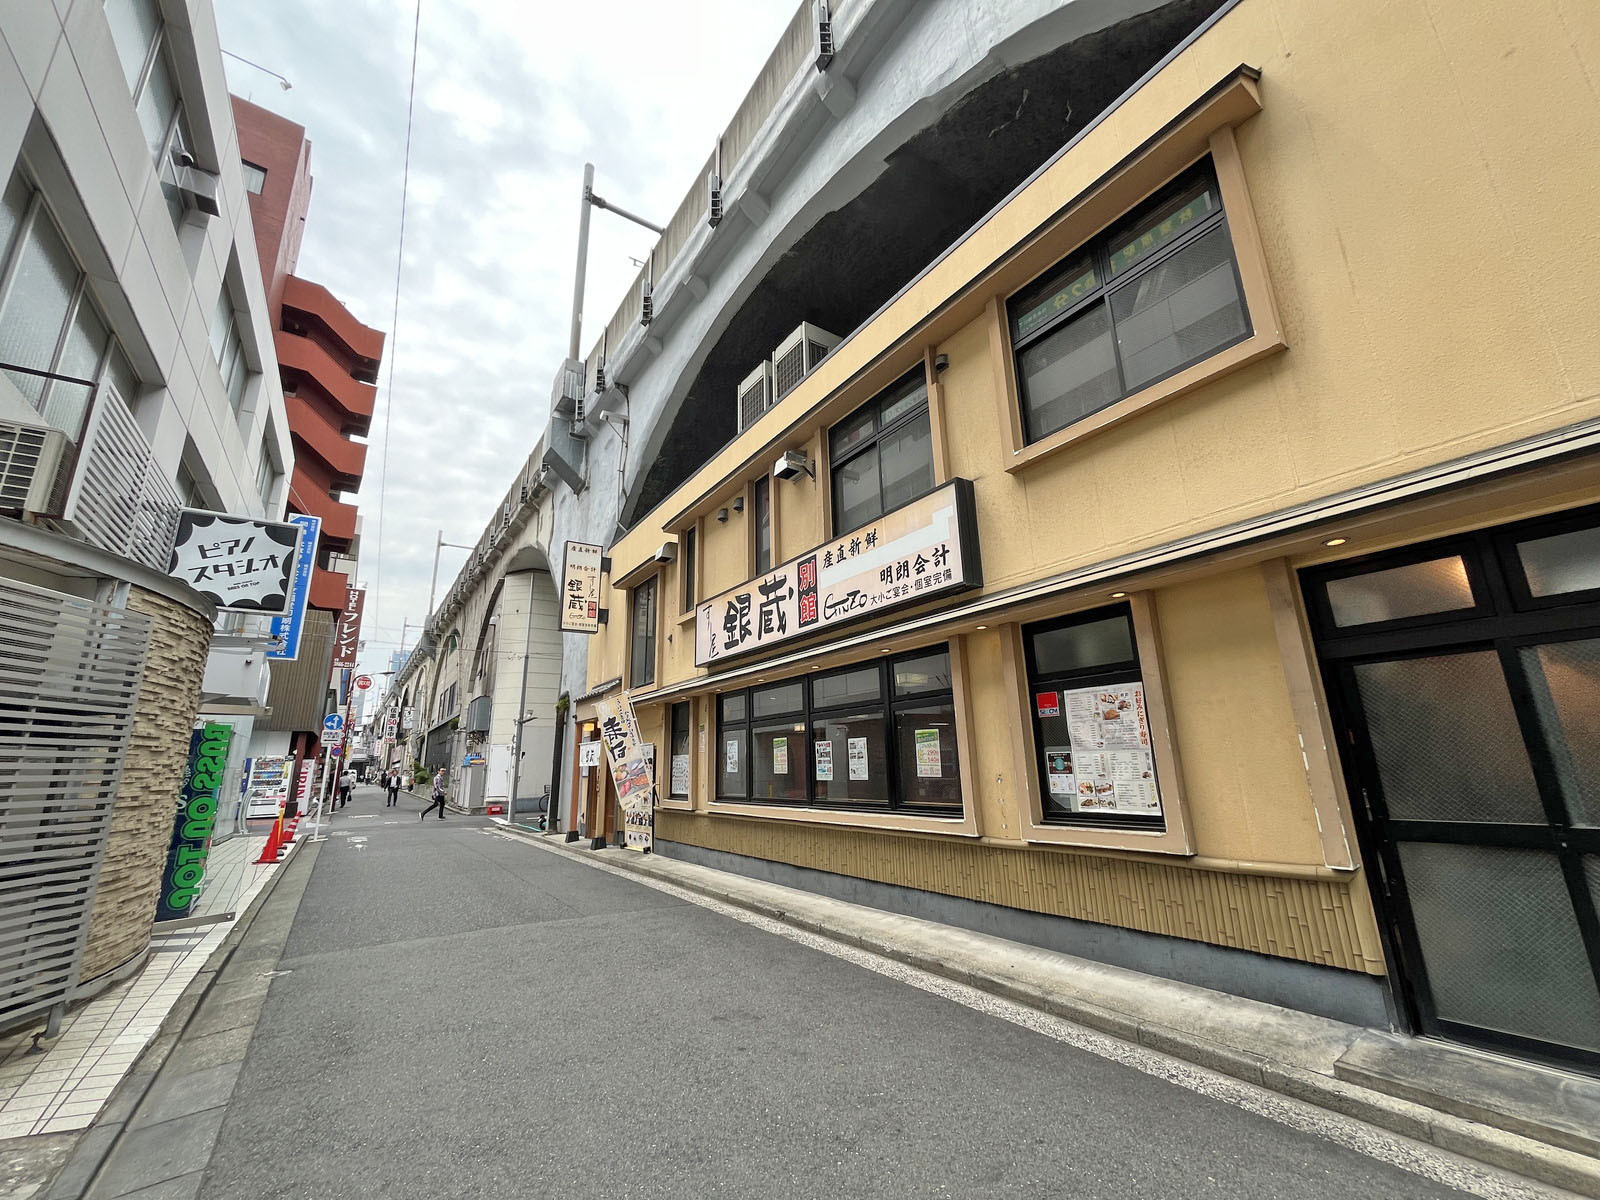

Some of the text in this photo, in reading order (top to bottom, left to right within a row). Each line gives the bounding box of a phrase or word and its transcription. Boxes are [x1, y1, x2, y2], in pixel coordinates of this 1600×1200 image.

[198, 536, 256, 560] ピアノ
[822, 527, 878, 569] 産直新鮮
[880, 544, 951, 585] 明朗会計
[188, 554, 279, 583] スタジオ
[870, 568, 953, 606] 大小ご宴会・個室完備
[348, 590, 359, 611] HOTEL
[567, 579, 588, 611] 銀蔵
[799, 560, 817, 623] 別館
[723, 574, 794, 651] 銀蔵
[340, 611, 359, 658] フレンド
